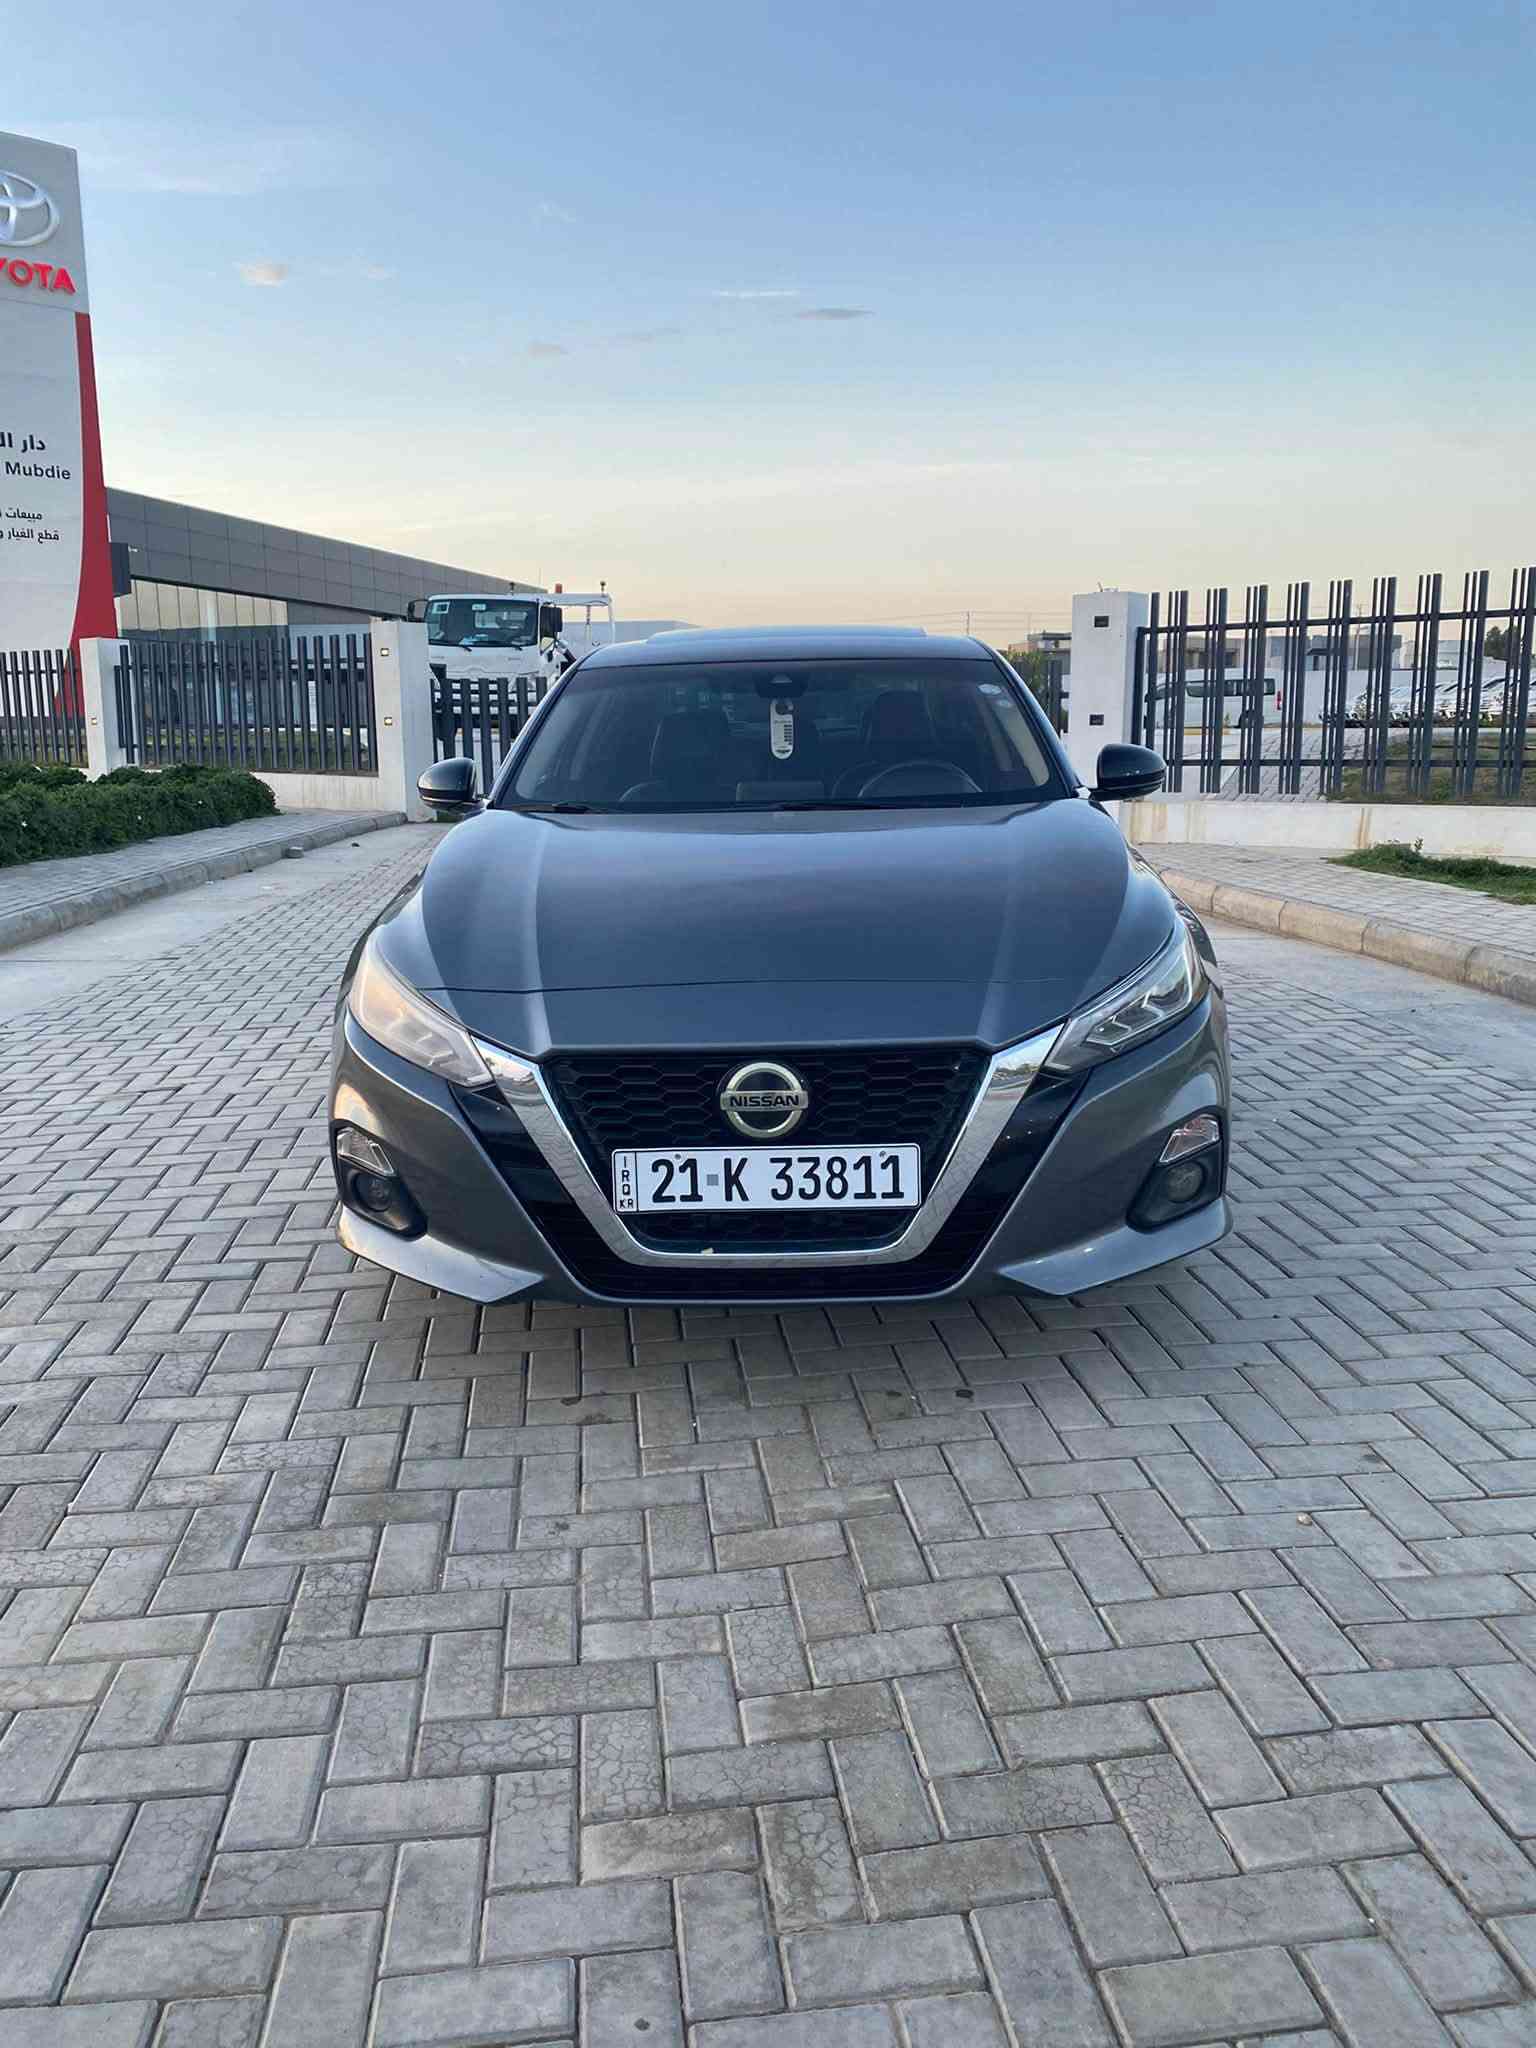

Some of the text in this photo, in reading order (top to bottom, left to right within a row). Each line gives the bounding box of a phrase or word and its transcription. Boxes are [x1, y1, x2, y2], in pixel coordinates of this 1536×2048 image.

[21, 434, 46, 453] دار
[5, 461, 71, 480] Mubdie
[5, 507, 43, 522] مبيعات
[8, 527, 34, 541] الغيار
[37, 529, 60, 544] قطع
[729, 1095, 799, 1107] NISSAN
[651, 1155, 905, 1203] 21 K 33811
